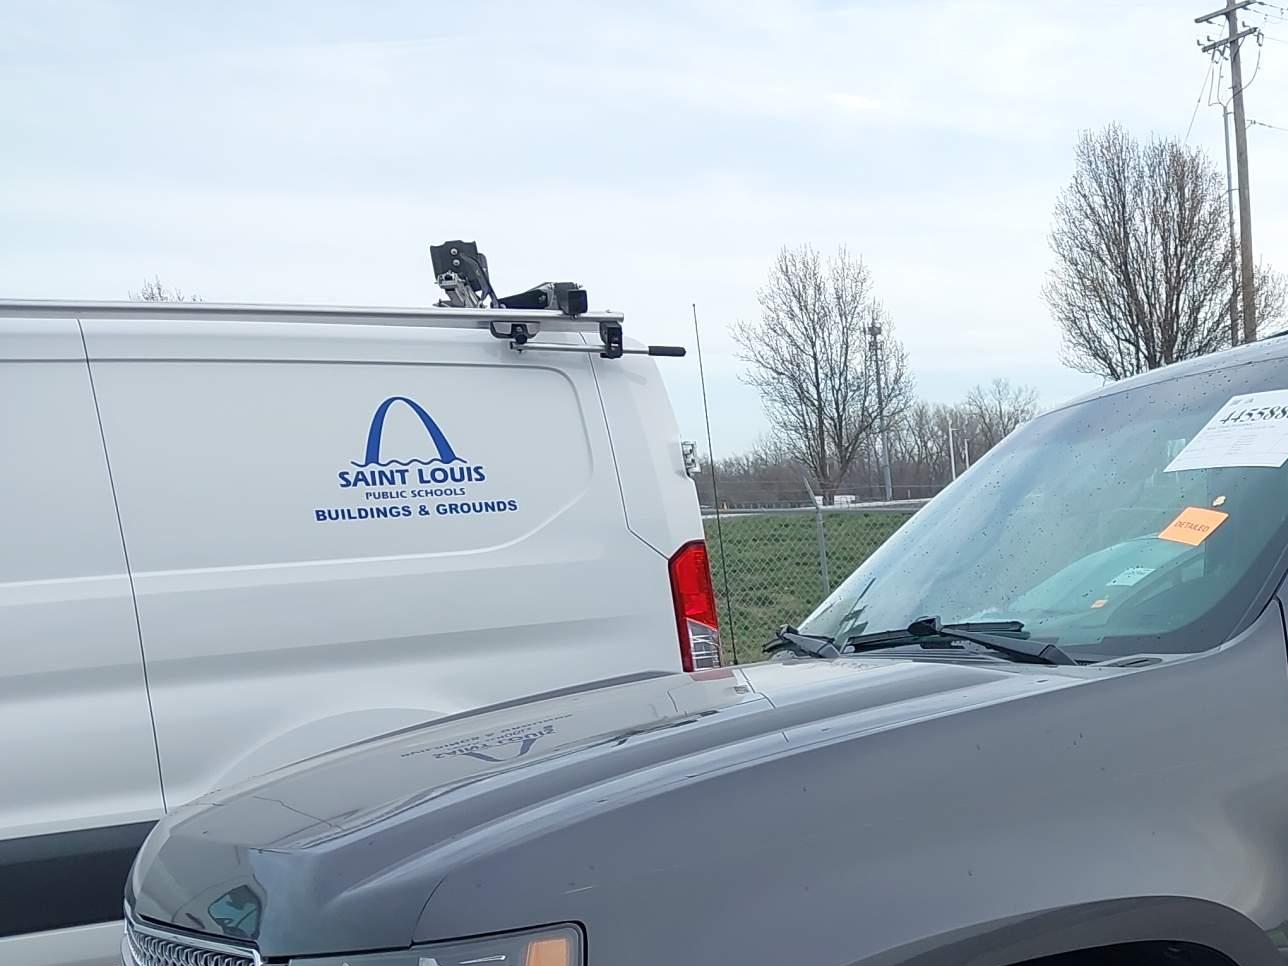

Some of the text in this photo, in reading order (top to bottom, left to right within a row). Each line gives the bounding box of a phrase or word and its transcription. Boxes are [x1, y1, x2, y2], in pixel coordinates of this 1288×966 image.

[338, 465, 486, 488] SAINT LOUIS
[365, 487, 466, 500] PUBLIC SCHOOLS
[315, 500, 519, 522] BUILDINGS & GROUNDS
[1173, 520, 1211, 533] DETAILED
